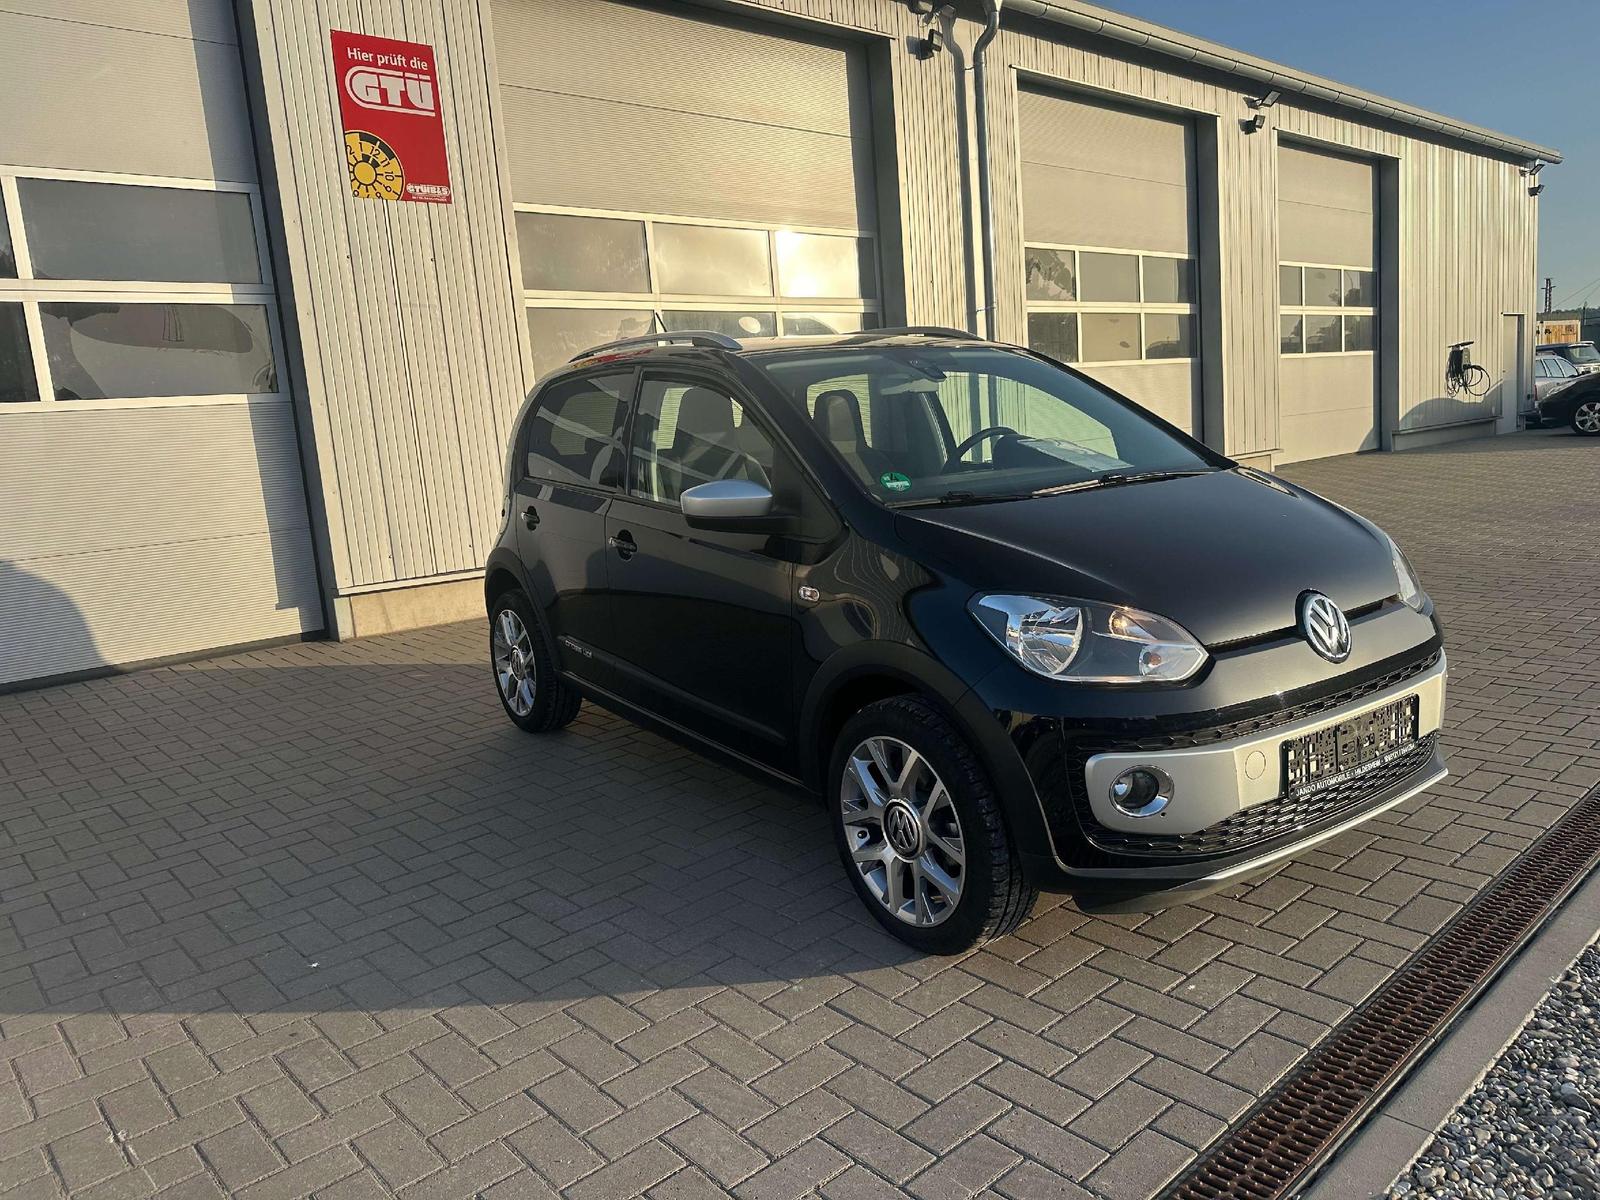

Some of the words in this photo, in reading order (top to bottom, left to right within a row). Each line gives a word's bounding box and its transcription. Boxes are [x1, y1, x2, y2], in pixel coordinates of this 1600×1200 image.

[347, 46, 374, 62] Hier
[376, 53, 407, 67] prüft
[409, 56, 428, 71] die
[350, 70, 435, 111] GTÜ
[358, 141, 364, 152] 1
[369, 145, 381, 160] 12
[380, 157, 391, 168] 11
[384, 170, 395, 182] 10
[1304, 594, 1351, 658] VW
[1295, 785, 1316, 797] JANDO
[1316, 771, 1351, 790] AUTOMOBILE
